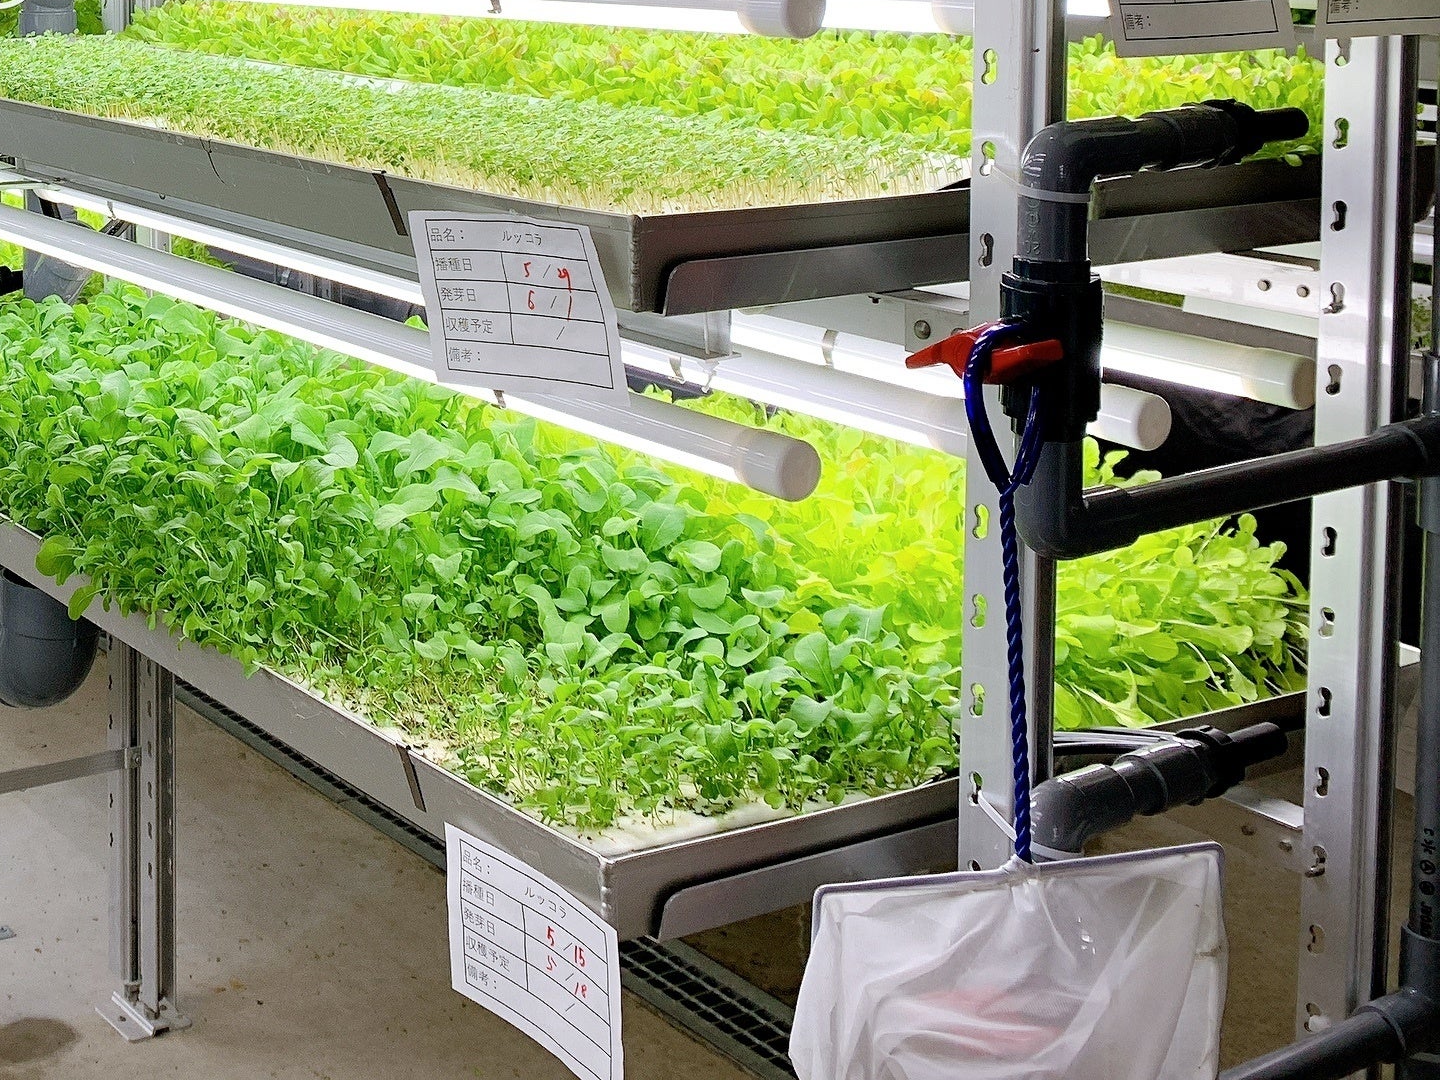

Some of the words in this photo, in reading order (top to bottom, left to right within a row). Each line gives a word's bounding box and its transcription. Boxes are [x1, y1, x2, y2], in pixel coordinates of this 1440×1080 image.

[502, 230, 543, 246] ルッコラ
[435, 256, 473, 272] 播種日
[440, 287, 477, 303] 発芽日
[446, 316, 494, 334] 収穫予定
[524, 886, 567, 919] ルッコラ
[463, 907, 496, 936] 発芽日
[466, 934, 511, 971] 収穫予定
